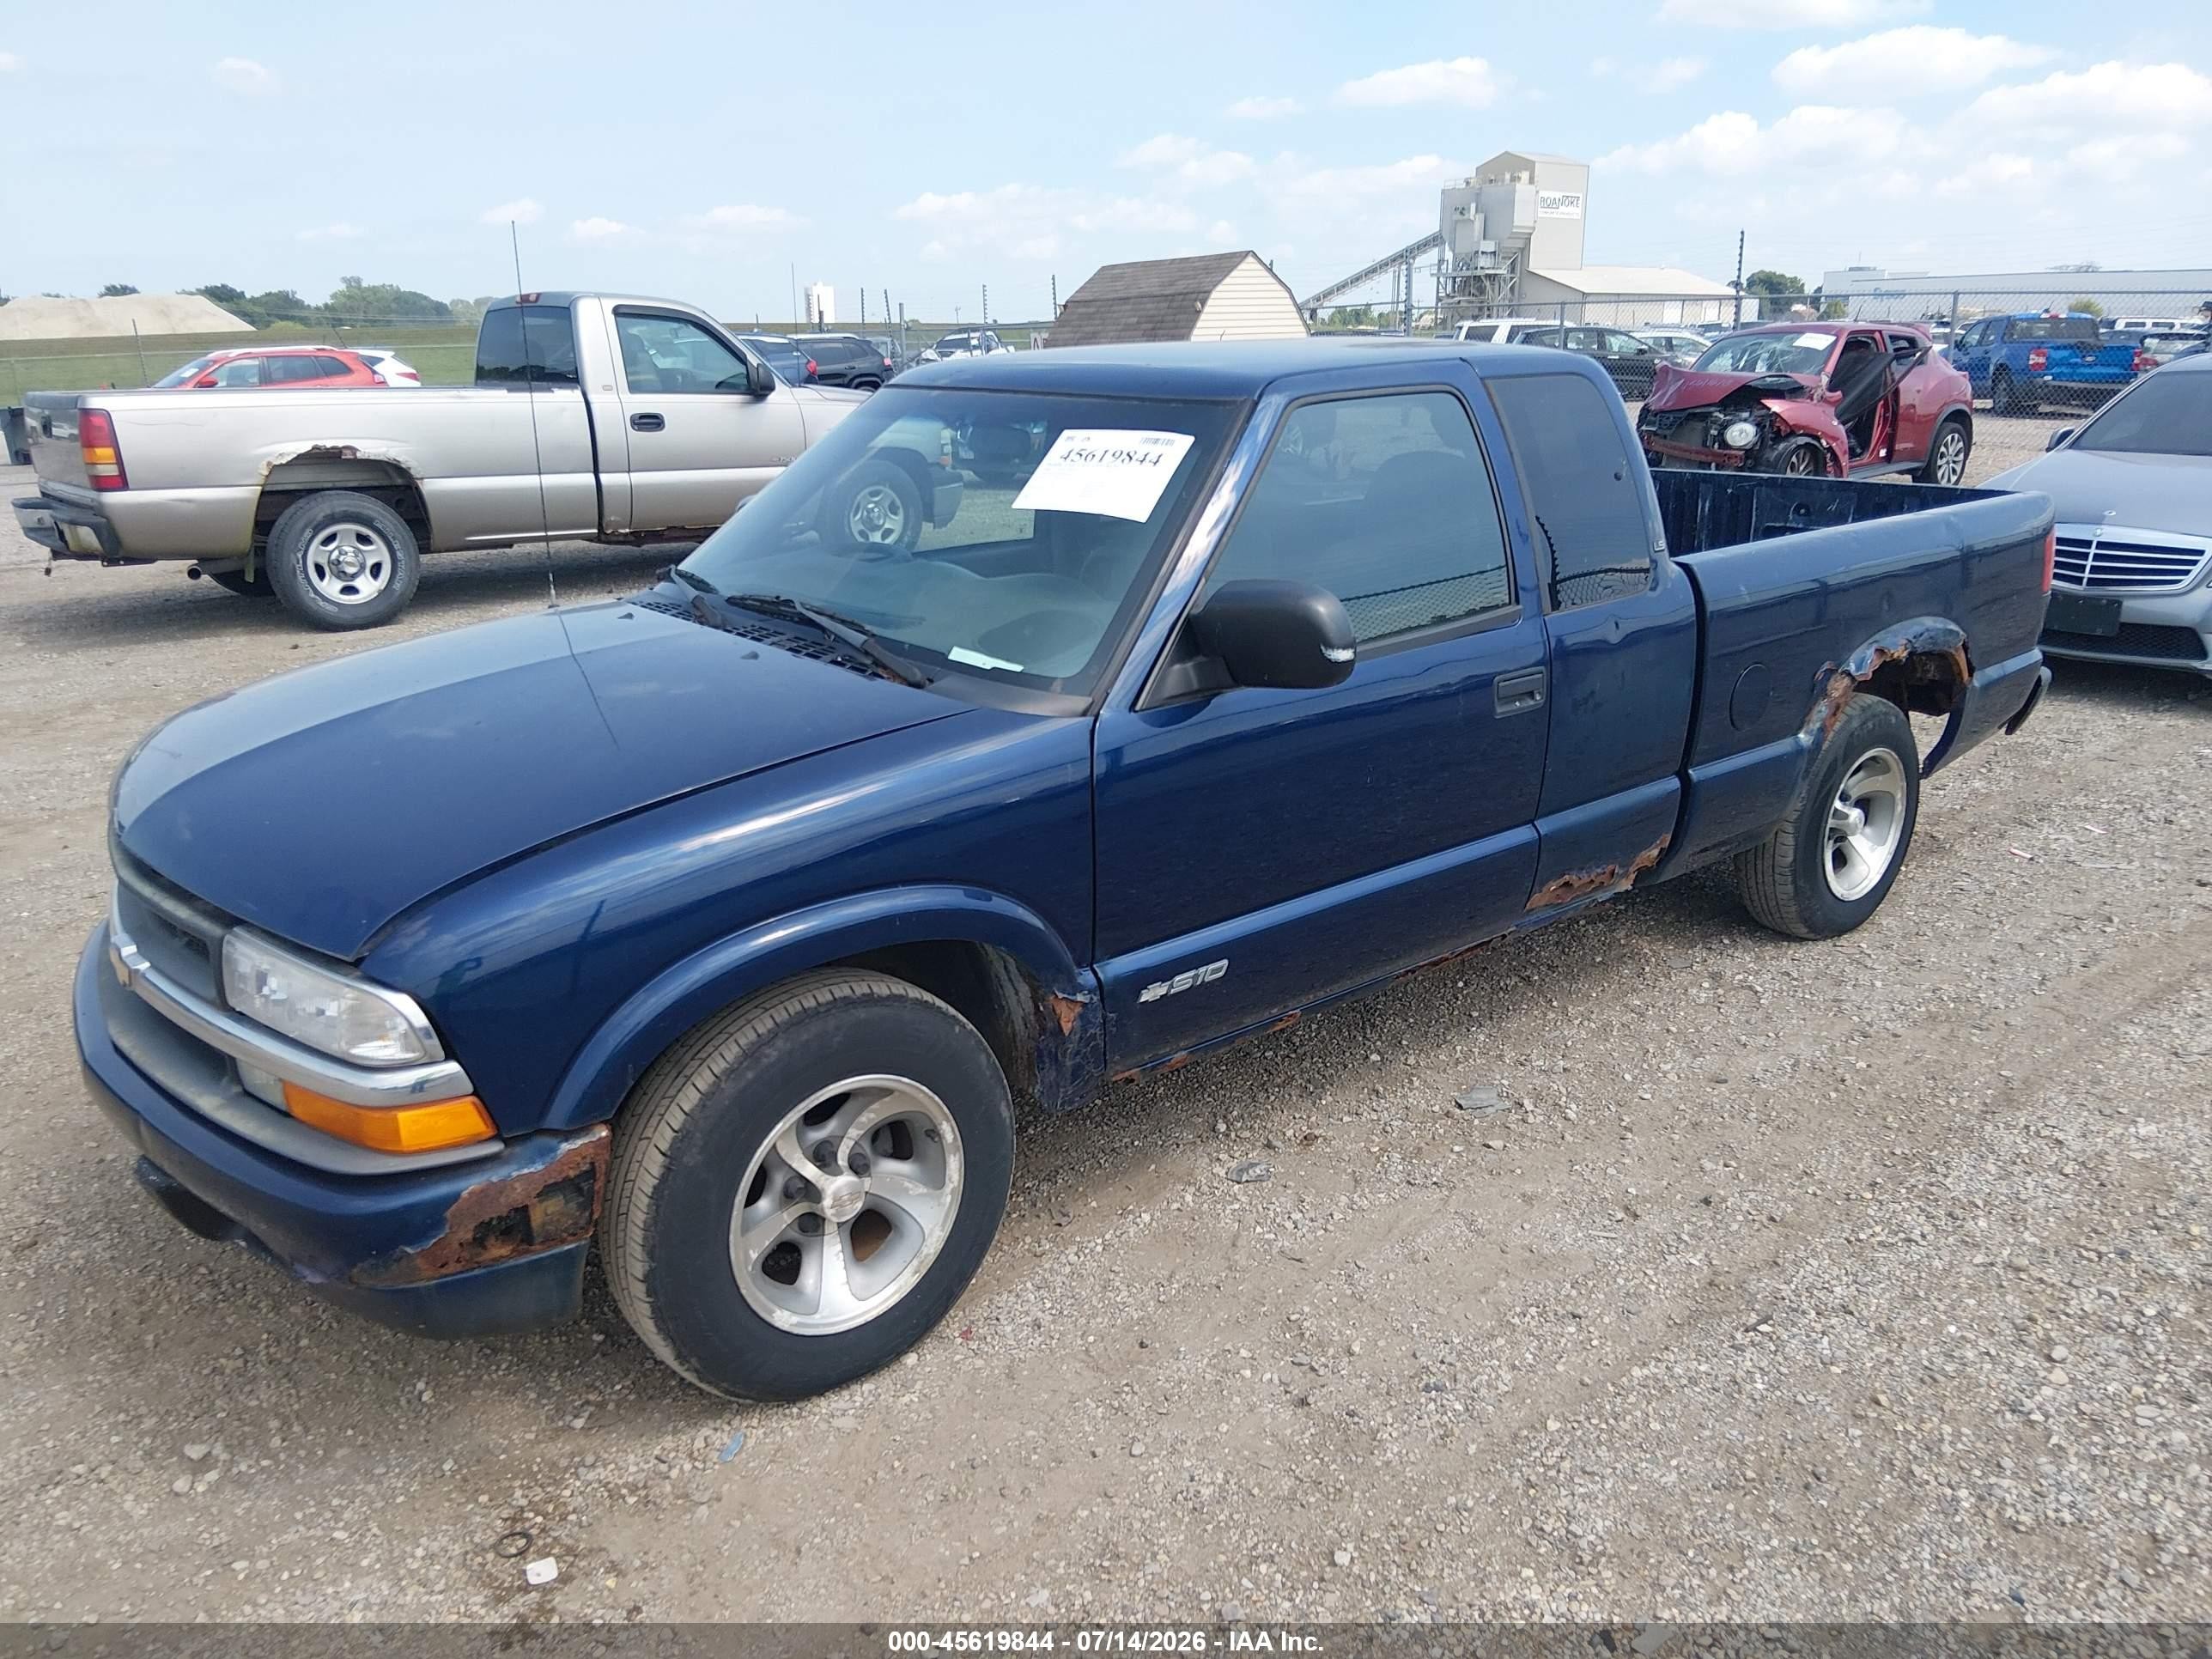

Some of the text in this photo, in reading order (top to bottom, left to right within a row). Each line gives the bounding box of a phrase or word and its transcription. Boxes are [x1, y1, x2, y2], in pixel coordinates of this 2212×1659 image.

[1540, 195, 1581, 209] ROANOKE
[1060, 447, 1164, 466] 45619844
[1653, 540, 1666, 552] LS
[1169, 958, 1230, 995] S10
